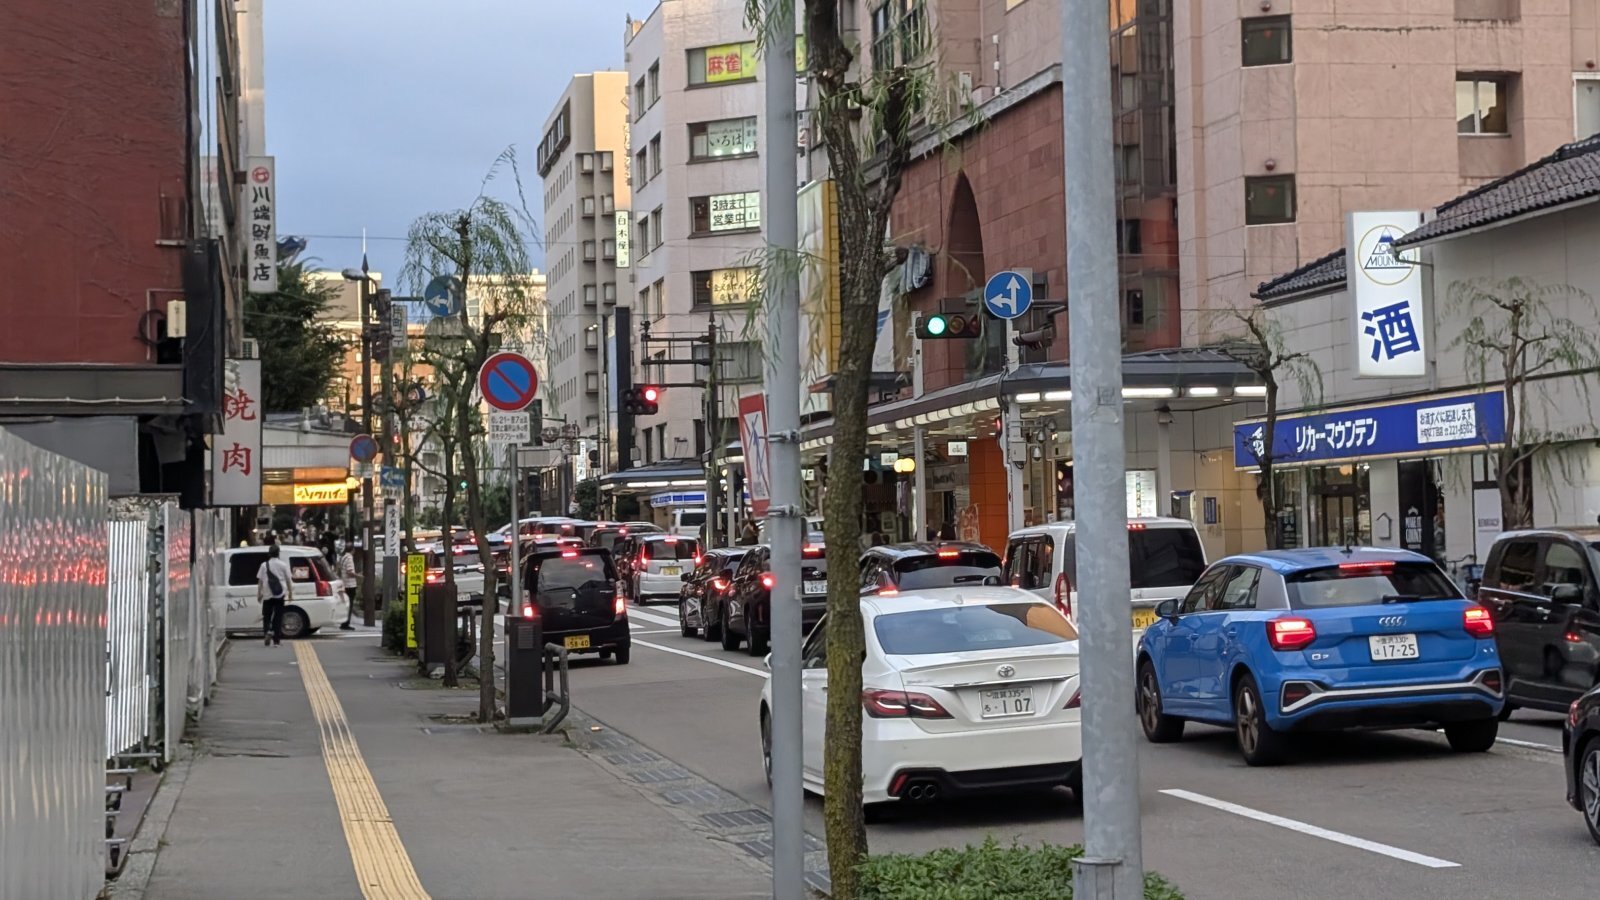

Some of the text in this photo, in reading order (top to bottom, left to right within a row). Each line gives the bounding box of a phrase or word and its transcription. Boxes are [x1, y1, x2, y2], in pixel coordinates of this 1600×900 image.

[708, 53, 741, 75] 麻雀
[709, 133, 742, 147] いろは
[1361, 300, 1420, 362] 酒
[222, 388, 256, 476] 焼肉
[1295, 418, 1377, 452] リカーマウンテン
[410, 565, 423, 573] 100
[226, 598, 248, 613] AXI
[1383, 644, 1416, 658] 17-25
